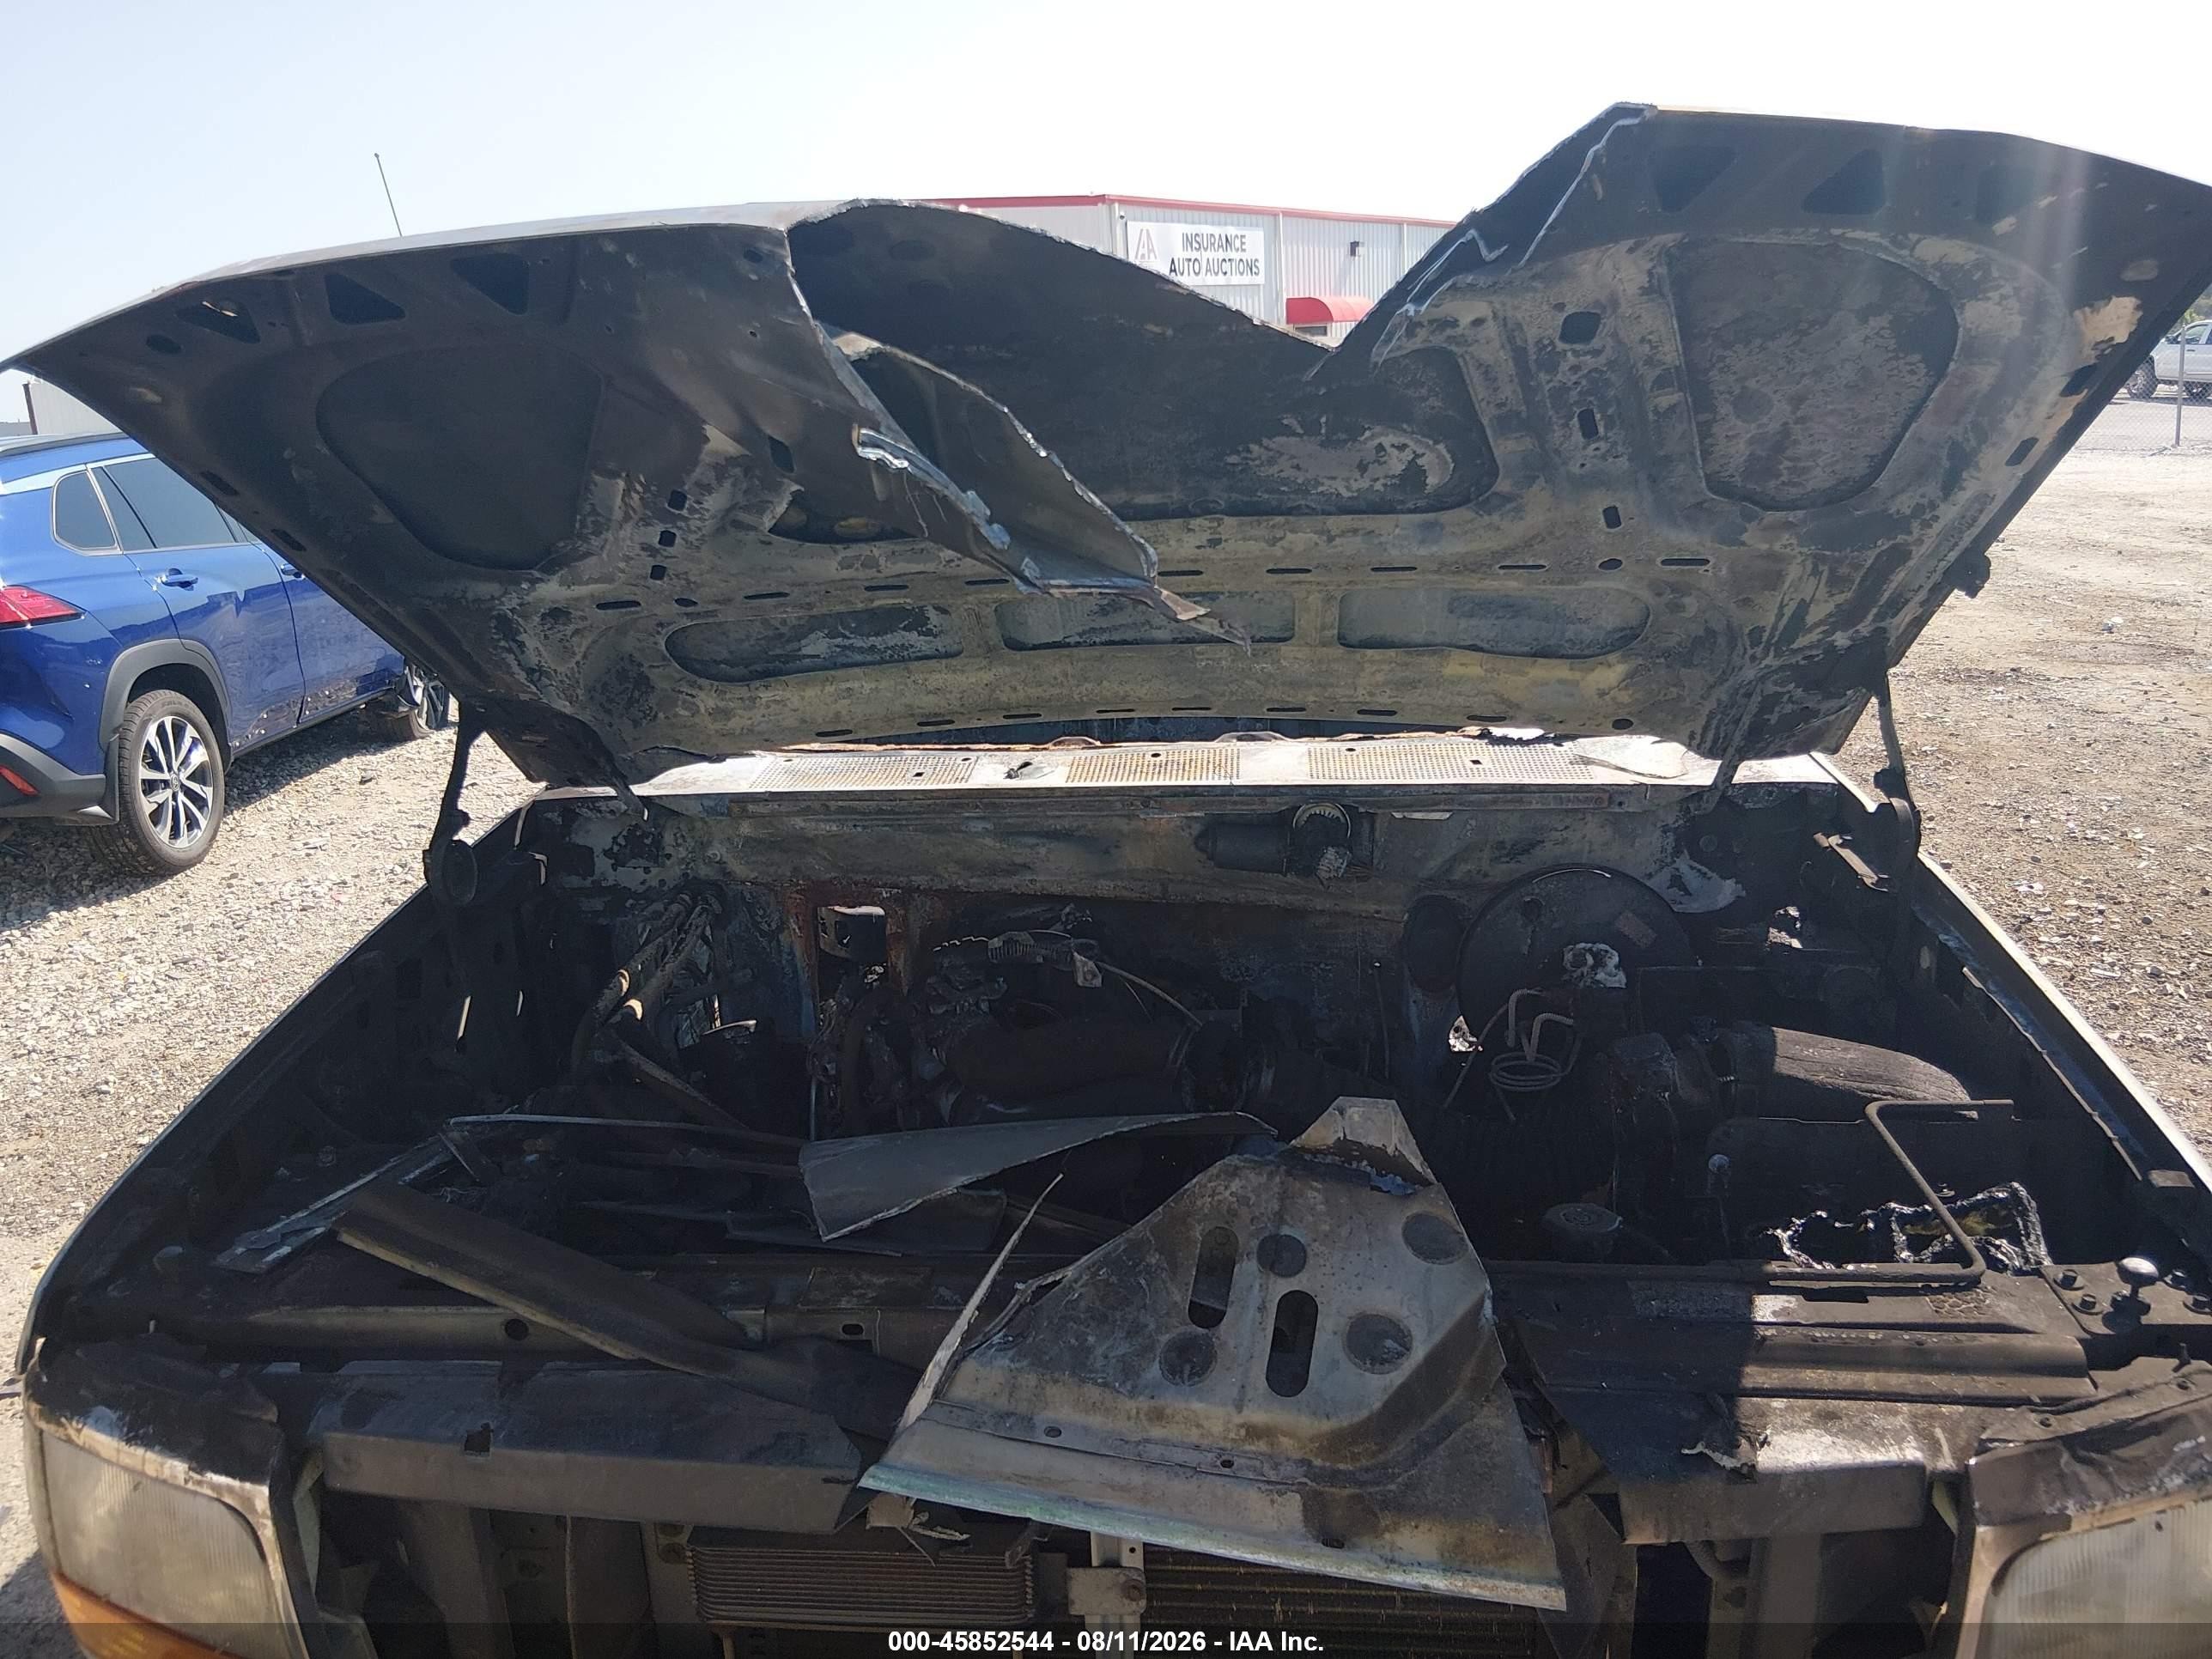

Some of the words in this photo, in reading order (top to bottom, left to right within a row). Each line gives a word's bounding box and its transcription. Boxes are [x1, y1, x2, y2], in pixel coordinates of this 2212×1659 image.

[1182, 232, 1247, 253] INSURANCE
[1169, 257, 1201, 276] AUTO
[1205, 258, 1261, 277] AUCTIONS
